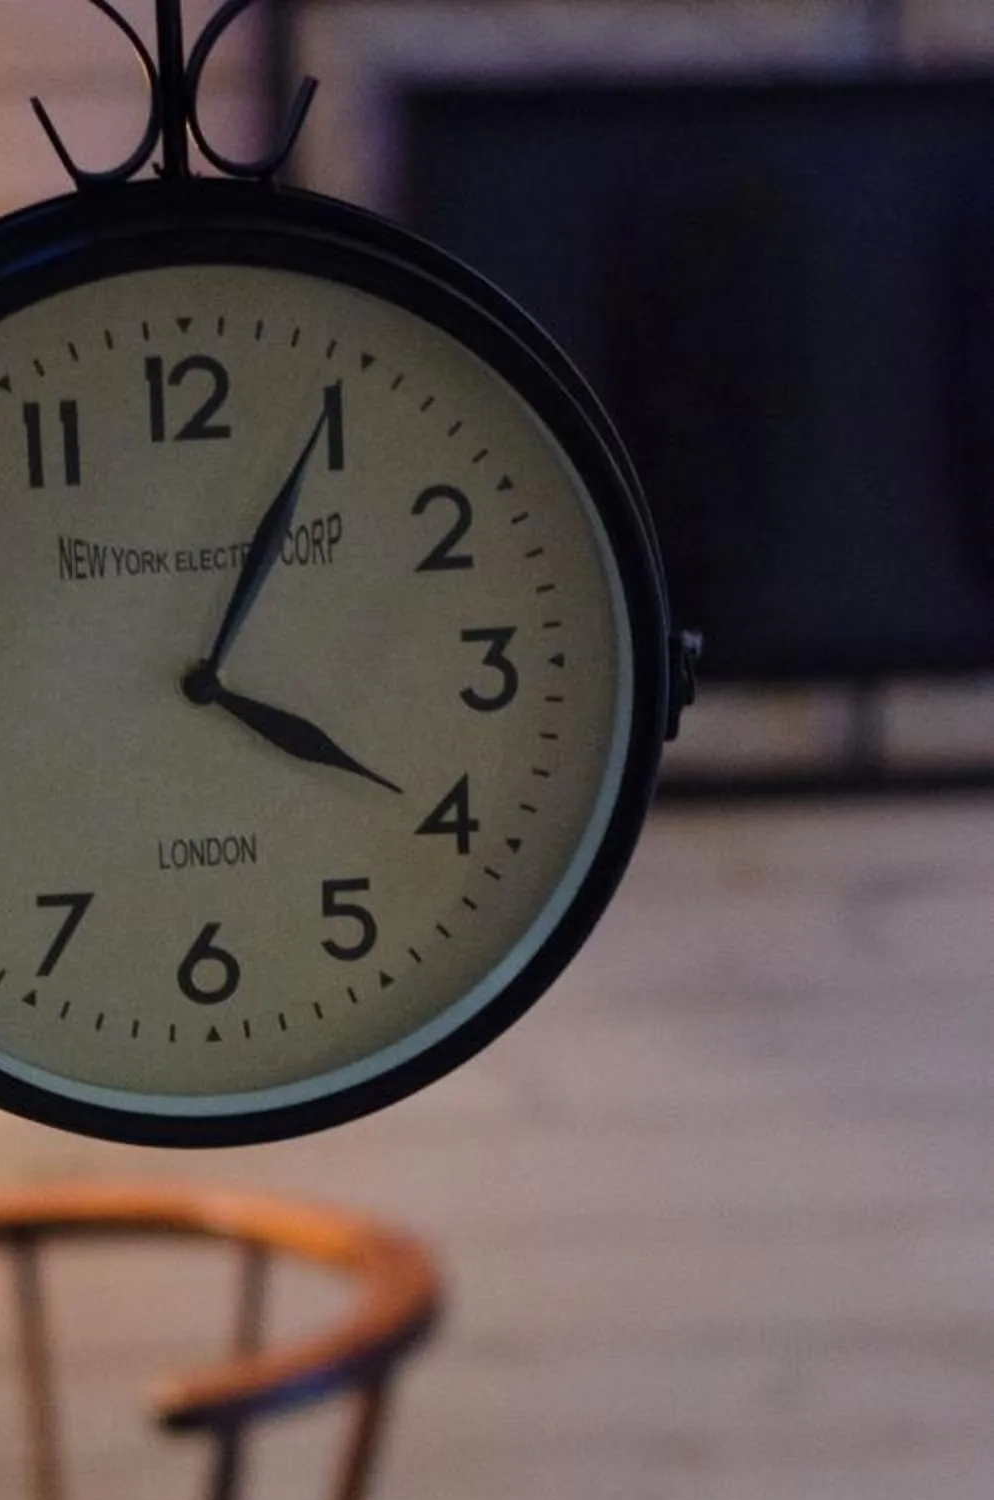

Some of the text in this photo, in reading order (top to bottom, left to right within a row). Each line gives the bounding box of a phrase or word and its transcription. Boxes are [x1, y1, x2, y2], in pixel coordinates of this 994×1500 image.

[143, 354, 232, 443] 12
[323, 380, 345, 472] 1
[21, 400, 82, 489] 11
[57, 535, 107, 580] NEW
[108, 546, 170, 577] YORK
[279, 512, 343, 566] CORP
[410, 484, 475, 573] 2
[459, 626, 519, 713] 3
[158, 834, 257, 870] LONDON
[413, 772, 480, 856] 4
[35, 891, 95, 978] 7
[176, 921, 241, 1006] 6
[320, 877, 378, 963] 5
